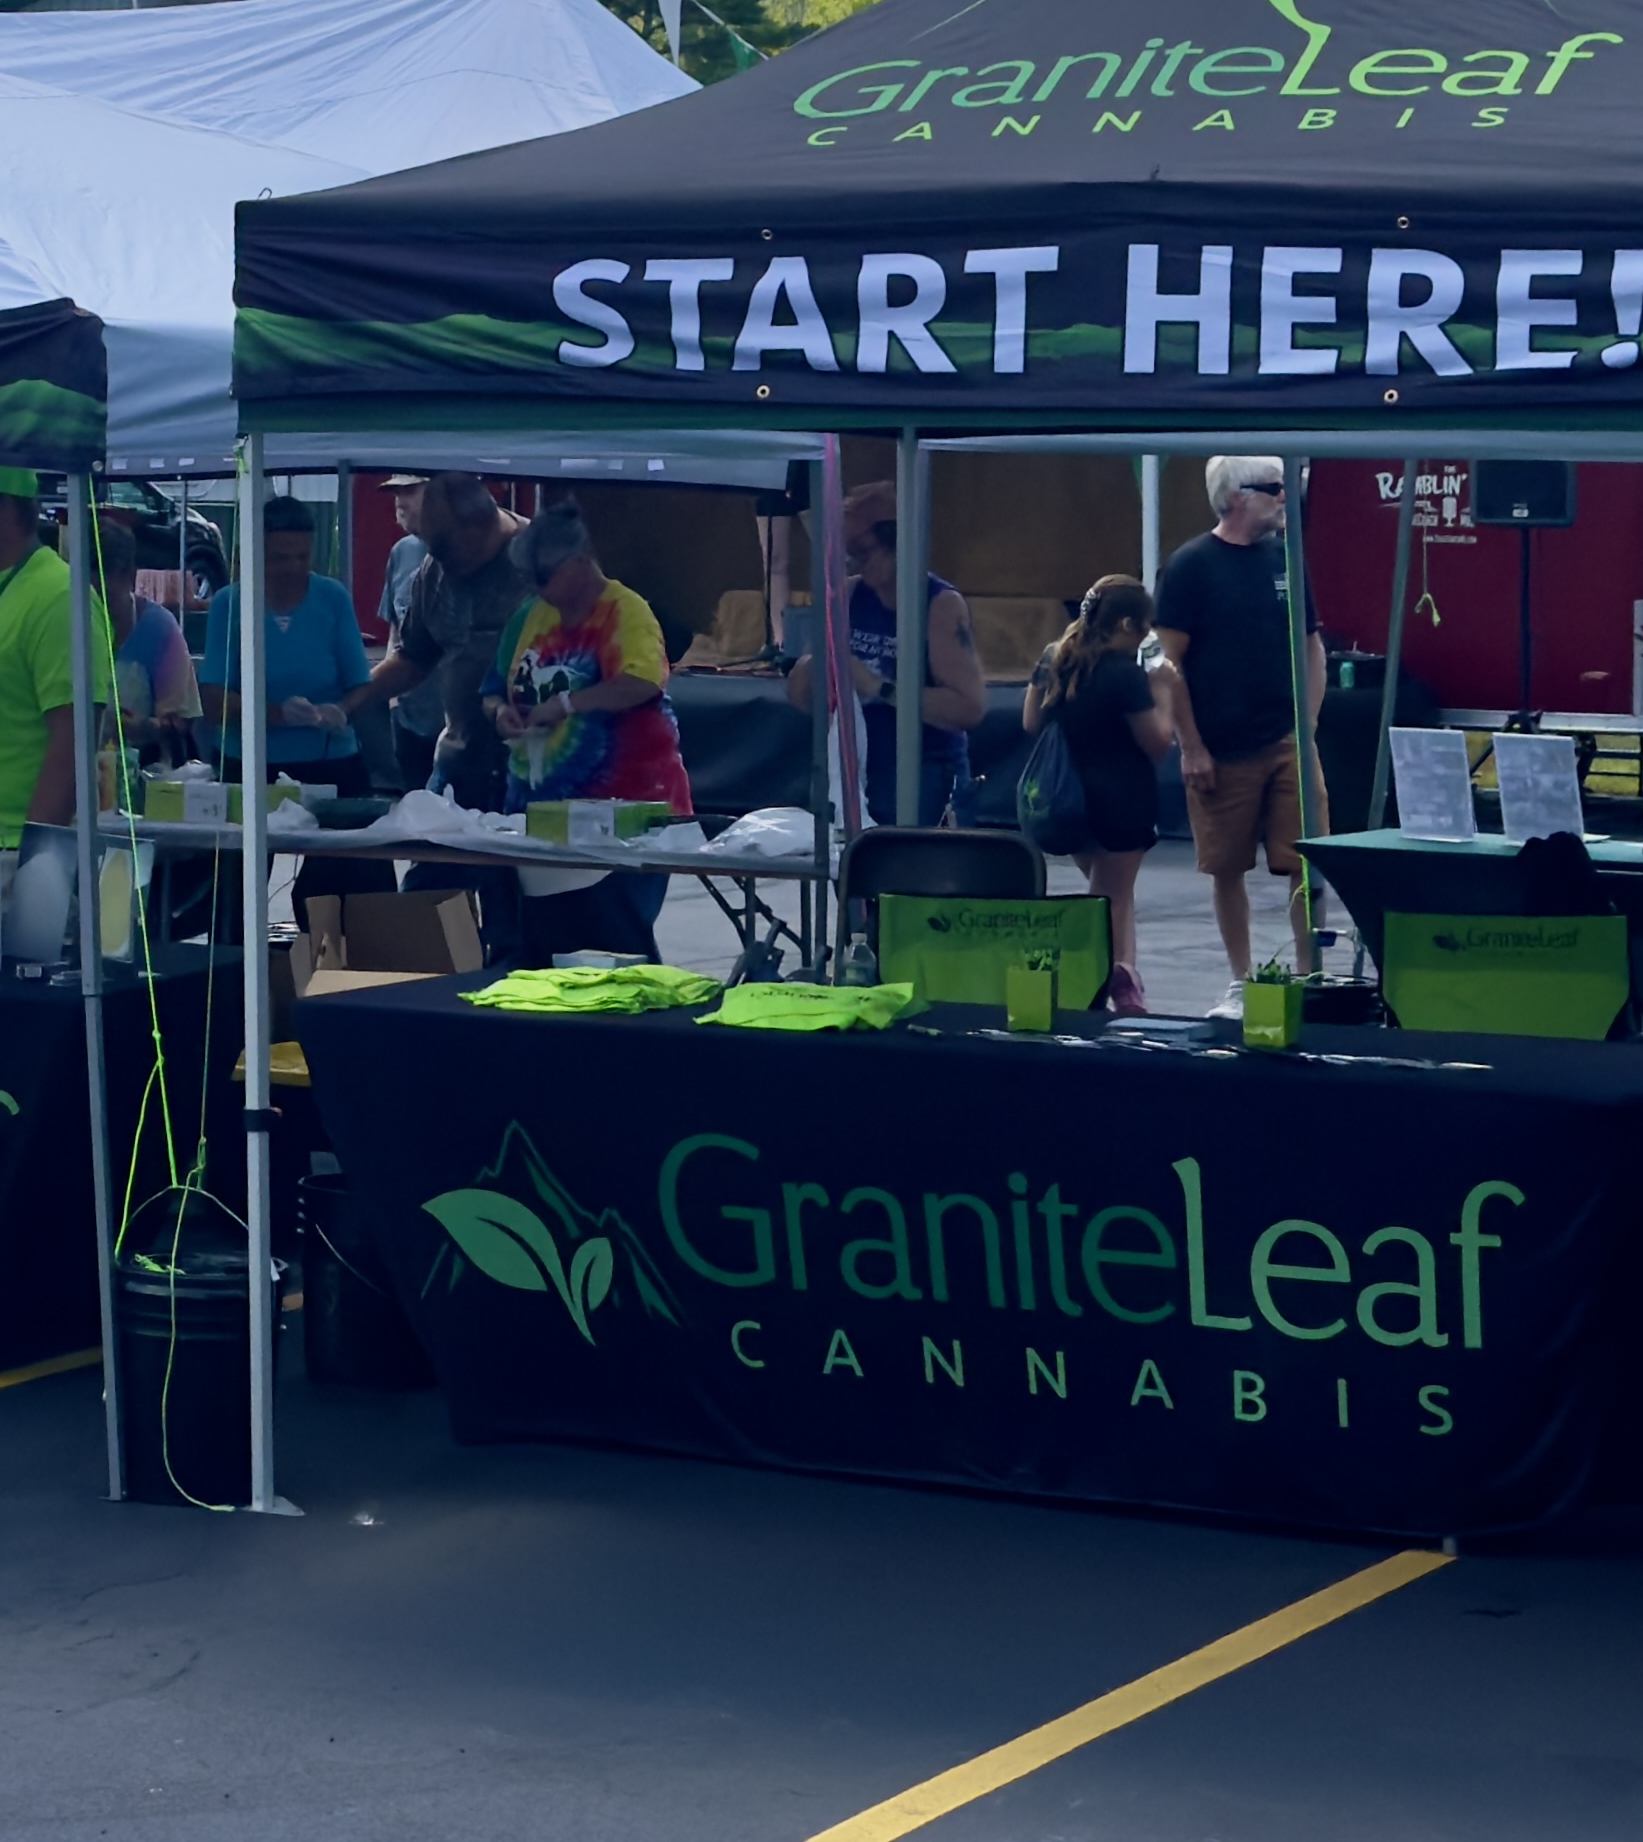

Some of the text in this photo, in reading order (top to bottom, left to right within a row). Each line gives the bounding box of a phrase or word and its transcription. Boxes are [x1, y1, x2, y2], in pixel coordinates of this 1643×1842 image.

[792, 31, 1623, 120] GraniteLeaf
[807, 107, 1510, 147] CANNABIS
[551, 245, 1060, 373] START
[657, 1131, 1526, 1349] GraniteLeaf
[730, 1320, 1454, 1436] CANNABIS
